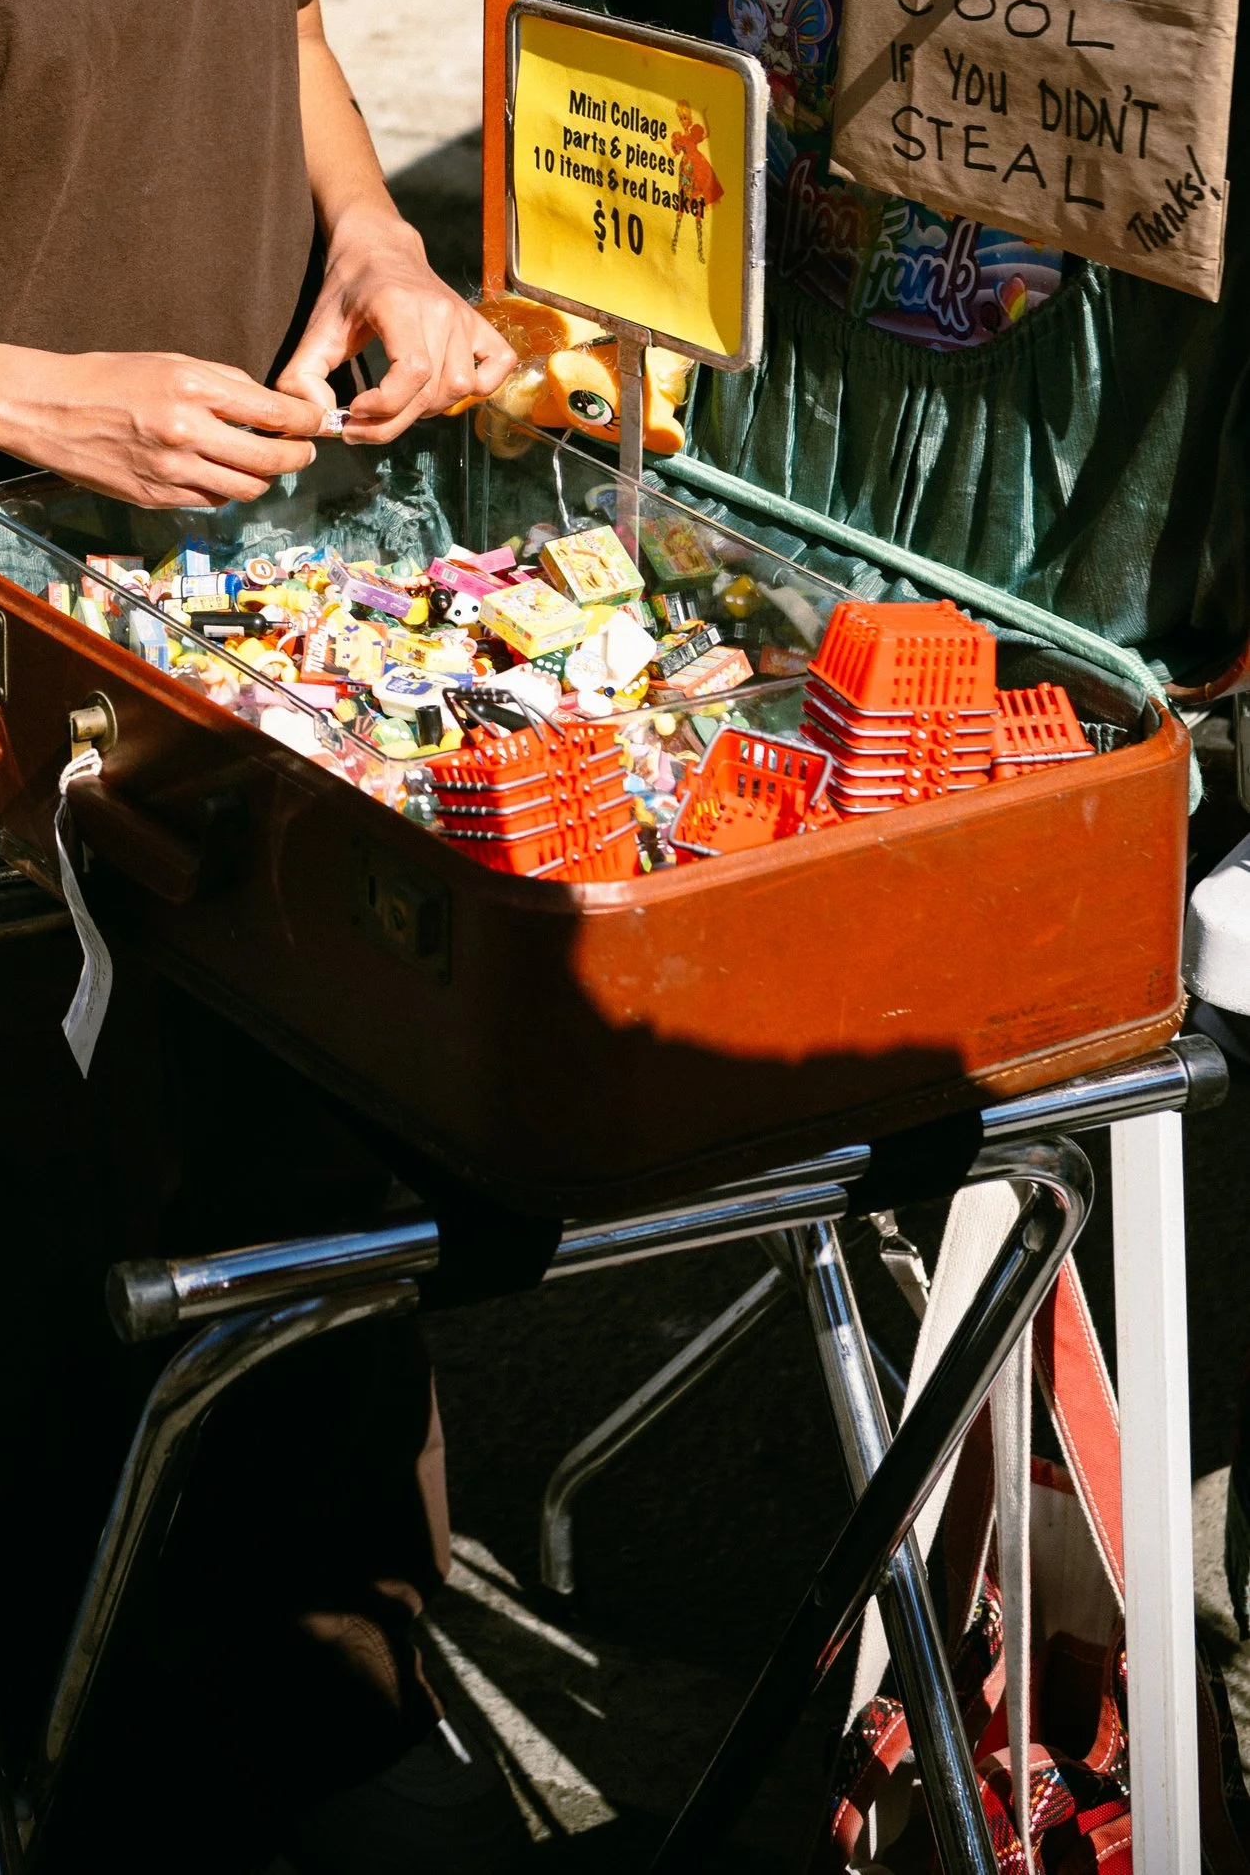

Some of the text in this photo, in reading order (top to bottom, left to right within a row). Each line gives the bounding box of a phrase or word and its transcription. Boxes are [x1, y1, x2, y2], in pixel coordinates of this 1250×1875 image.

[569, 89, 668, 142] Mini Collage
[891, 41, 1159, 159] IF YOU DIDN'T
[534, 145, 706, 219] 10 items & red basket
[563, 126, 675, 177] parts & pieces
[891, 105, 1105, 210] STEAL
[593, 199, 644, 256] $10
[1126, 144, 1222, 253] Thanks!
